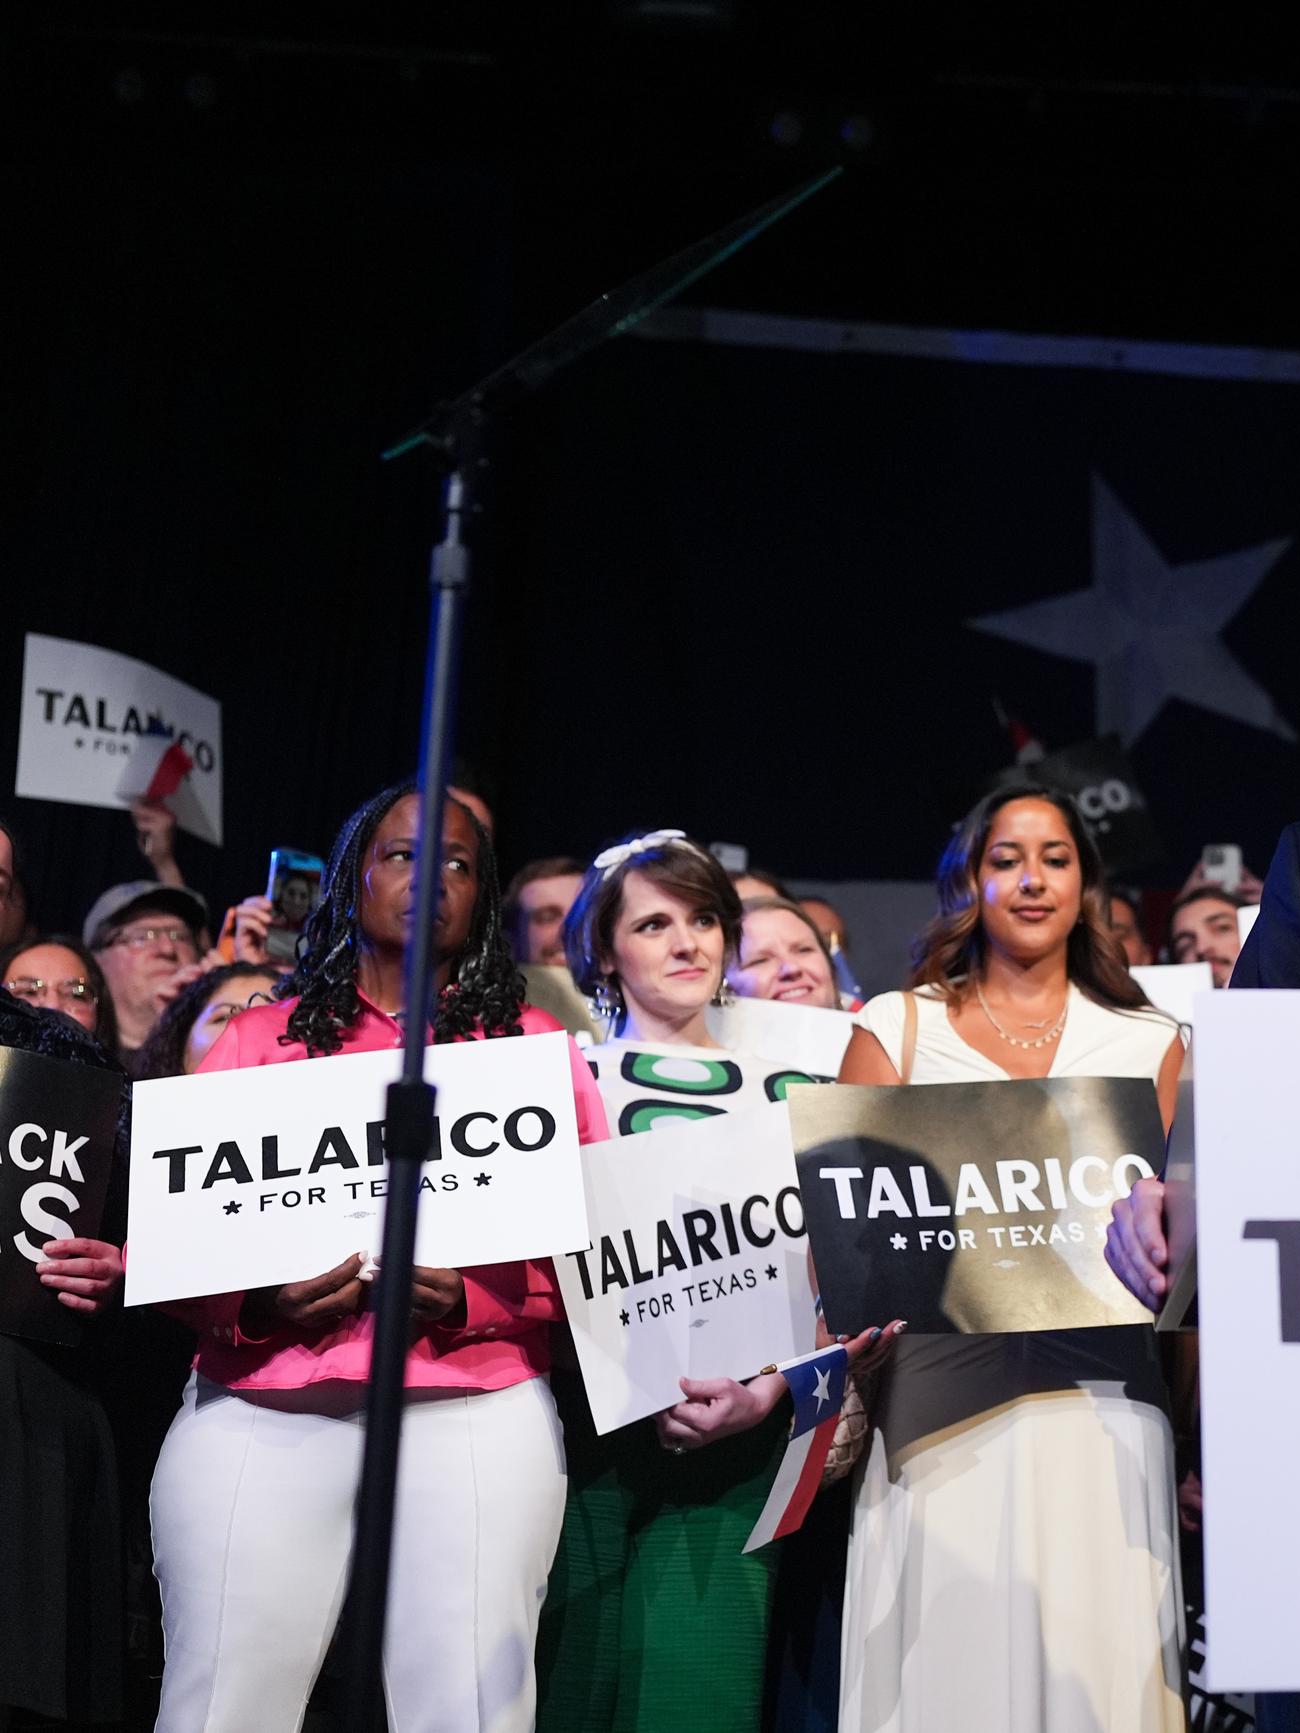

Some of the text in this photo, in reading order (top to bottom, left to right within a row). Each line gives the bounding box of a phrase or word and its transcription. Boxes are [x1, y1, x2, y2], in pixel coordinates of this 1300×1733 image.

[36, 687, 214, 773] TALAO
[259, 1173, 459, 1211] FOR TEAS
[819, 1153, 1155, 1219] TALARICO
[565, 1186, 807, 1300] TALARICO
[919, 1222, 1085, 1251] FOR TEXAS
[636, 1269, 757, 1323] FOR TEXAS
